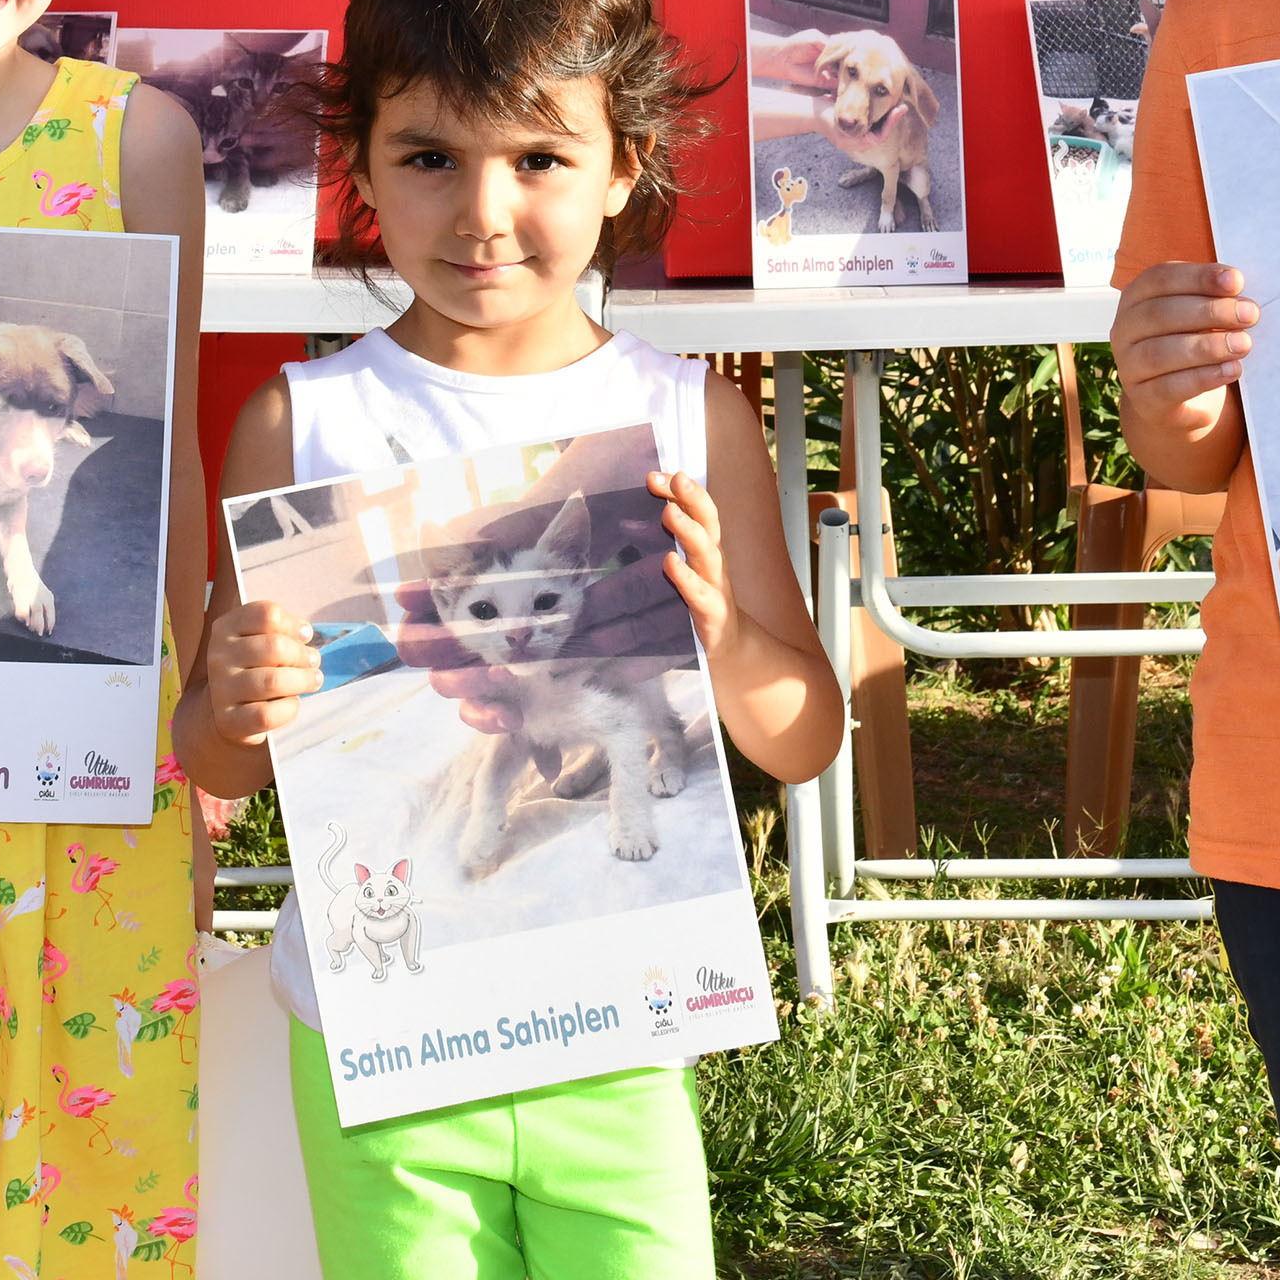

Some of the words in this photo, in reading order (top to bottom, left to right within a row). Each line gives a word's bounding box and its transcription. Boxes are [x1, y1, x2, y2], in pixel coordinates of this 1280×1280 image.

[767, 258, 799, 273] Satın
[802, 257, 835, 273] Alma
[838, 255, 894, 276] Sahiplen
[84, 750, 119, 776] Utku
[696, 965, 736, 993] Utku
[339, 1043, 413, 1082] Satın
[420, 1028, 491, 1066] Alma
[496, 1001, 621, 1050] Sahiplen
